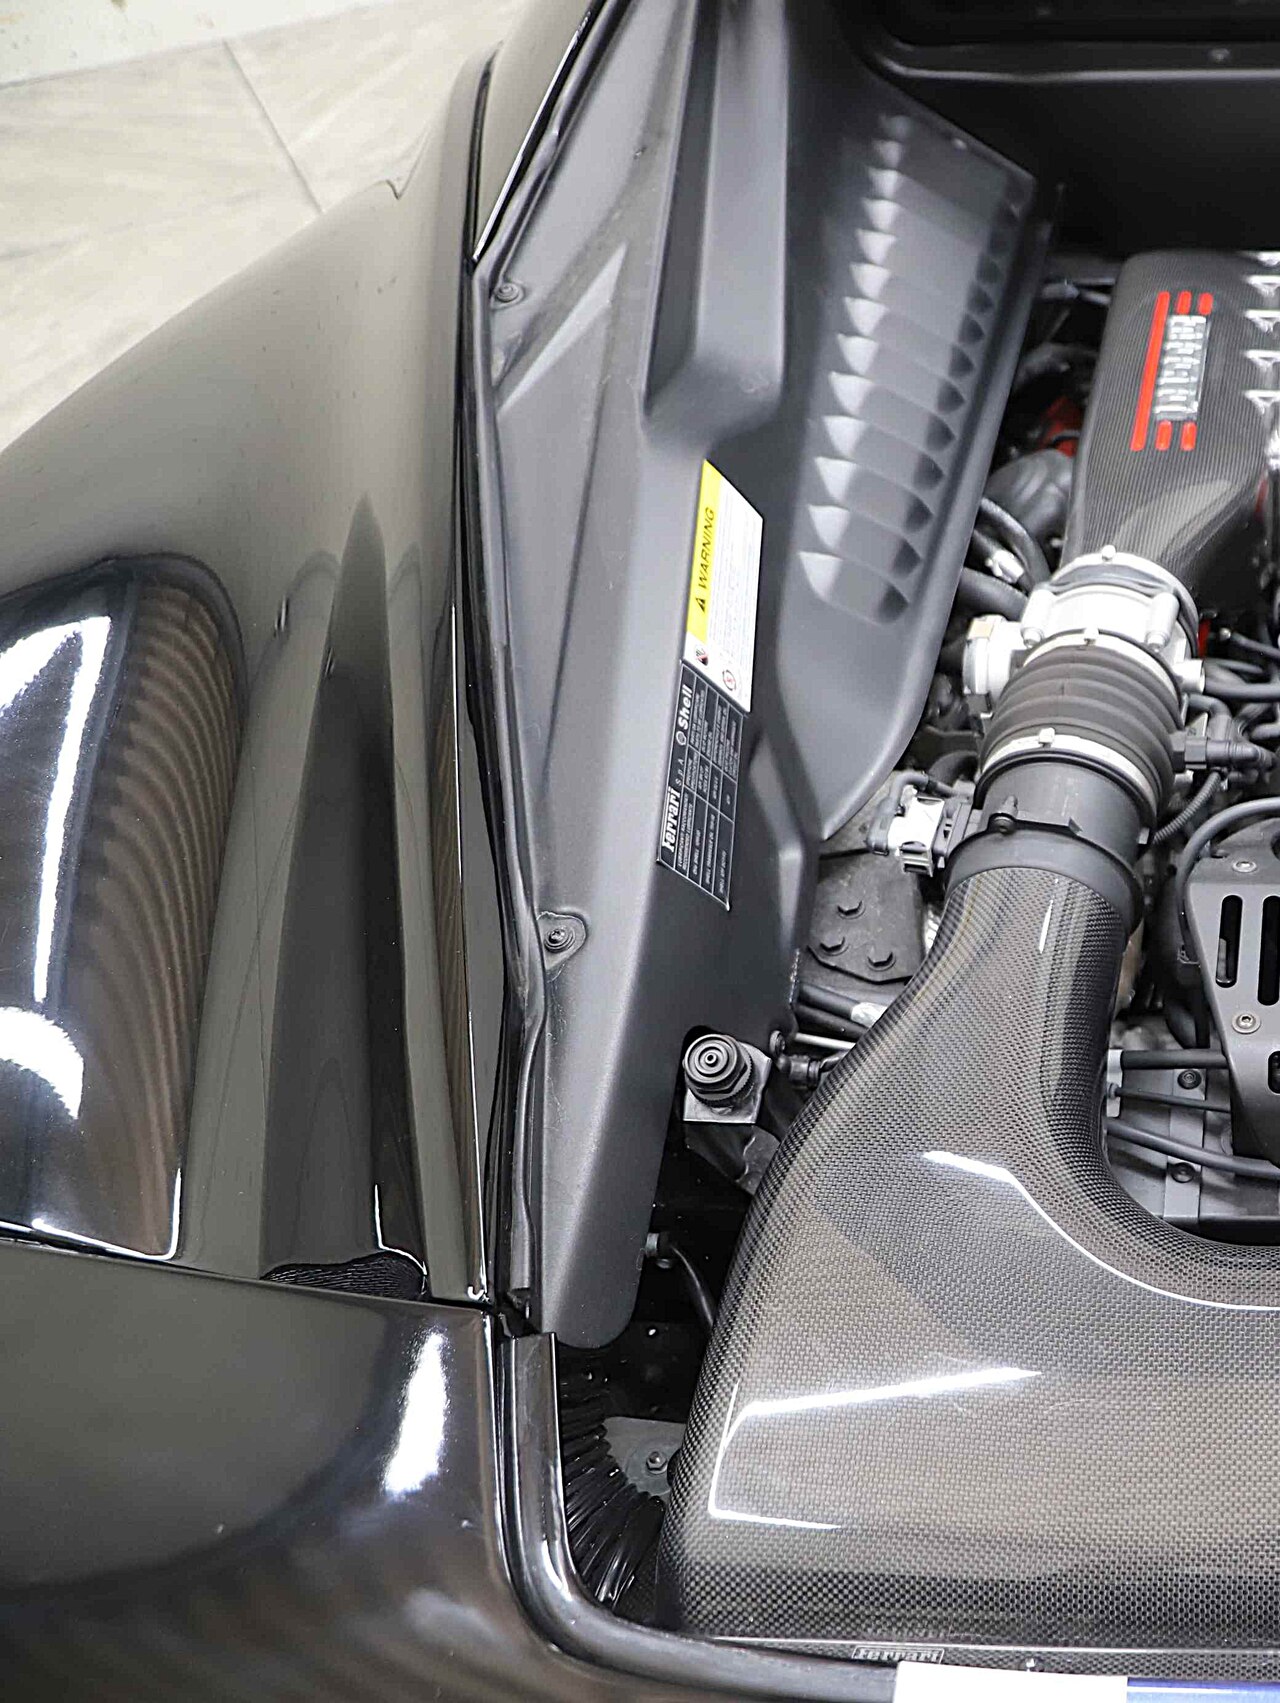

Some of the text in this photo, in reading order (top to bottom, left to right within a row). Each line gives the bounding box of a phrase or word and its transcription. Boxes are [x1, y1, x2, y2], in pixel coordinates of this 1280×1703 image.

[699, 506, 715, 592] WARNING
[662, 784, 681, 853] Ferrari
[678, 682, 692, 731] Shell
